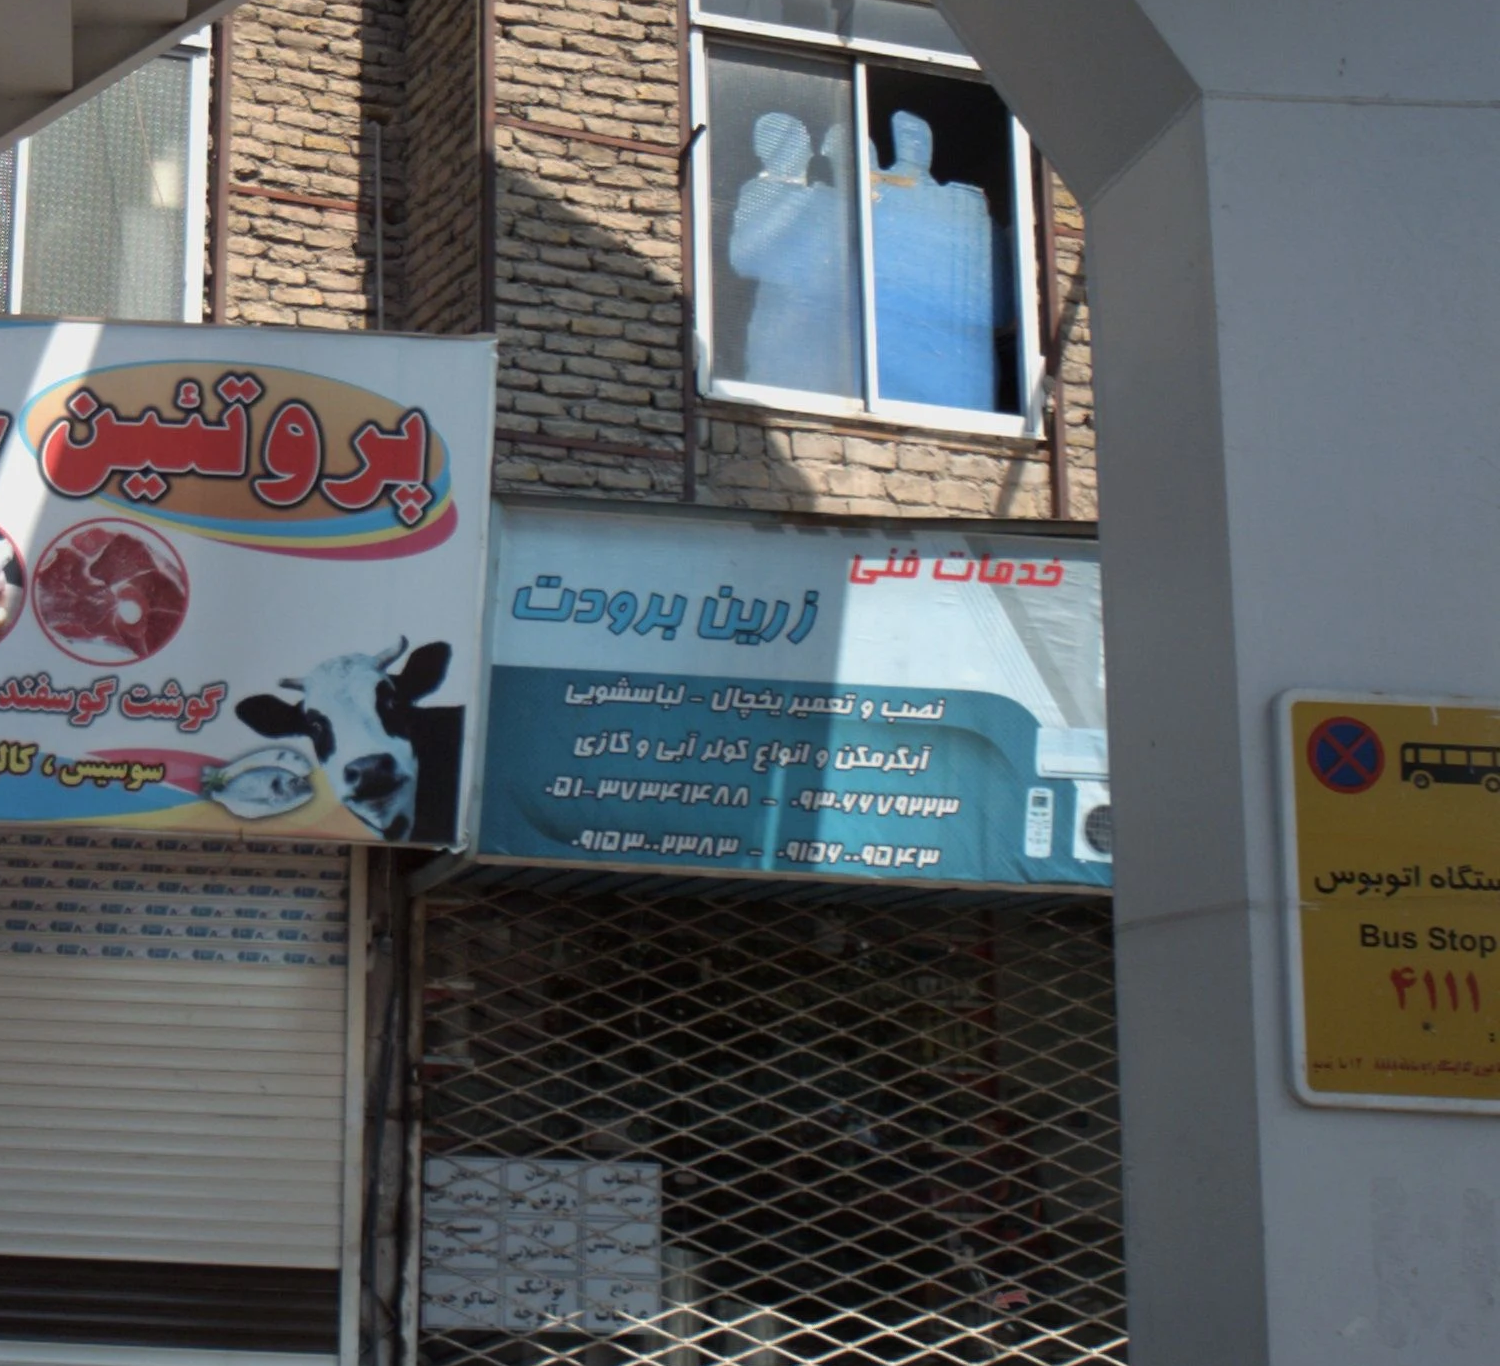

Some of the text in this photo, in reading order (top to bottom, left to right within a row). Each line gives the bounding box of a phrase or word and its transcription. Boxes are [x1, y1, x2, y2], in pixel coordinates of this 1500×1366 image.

[38, 371, 432, 526] پروتئین
[848, 546, 1066, 590] خدمات فنی
[511, 574, 820, 646] زرین برودت
[121, 679, 227, 733] گوشت
[564, 676, 687, 710] لباسشویی
[710, 685, 784, 719] یخچال
[787, 692, 857, 718] تعمیر
[860, 699, 875, 720] و
[880, 697, 946, 723] نصب
[573, 730, 633, 757] گازی
[635, 738, 651, 759] و
[655, 732, 700, 762] آبی
[700, 738, 750, 763] کولر
[752, 741, 812, 772] انواع
[815, 748, 830, 768] و
[1314, 865, 1421, 898] اتوبوس
[1359, 923, 1497, 959] Bus Stop
[1389, 966, 1481, 1014] ۴۱۱۱
